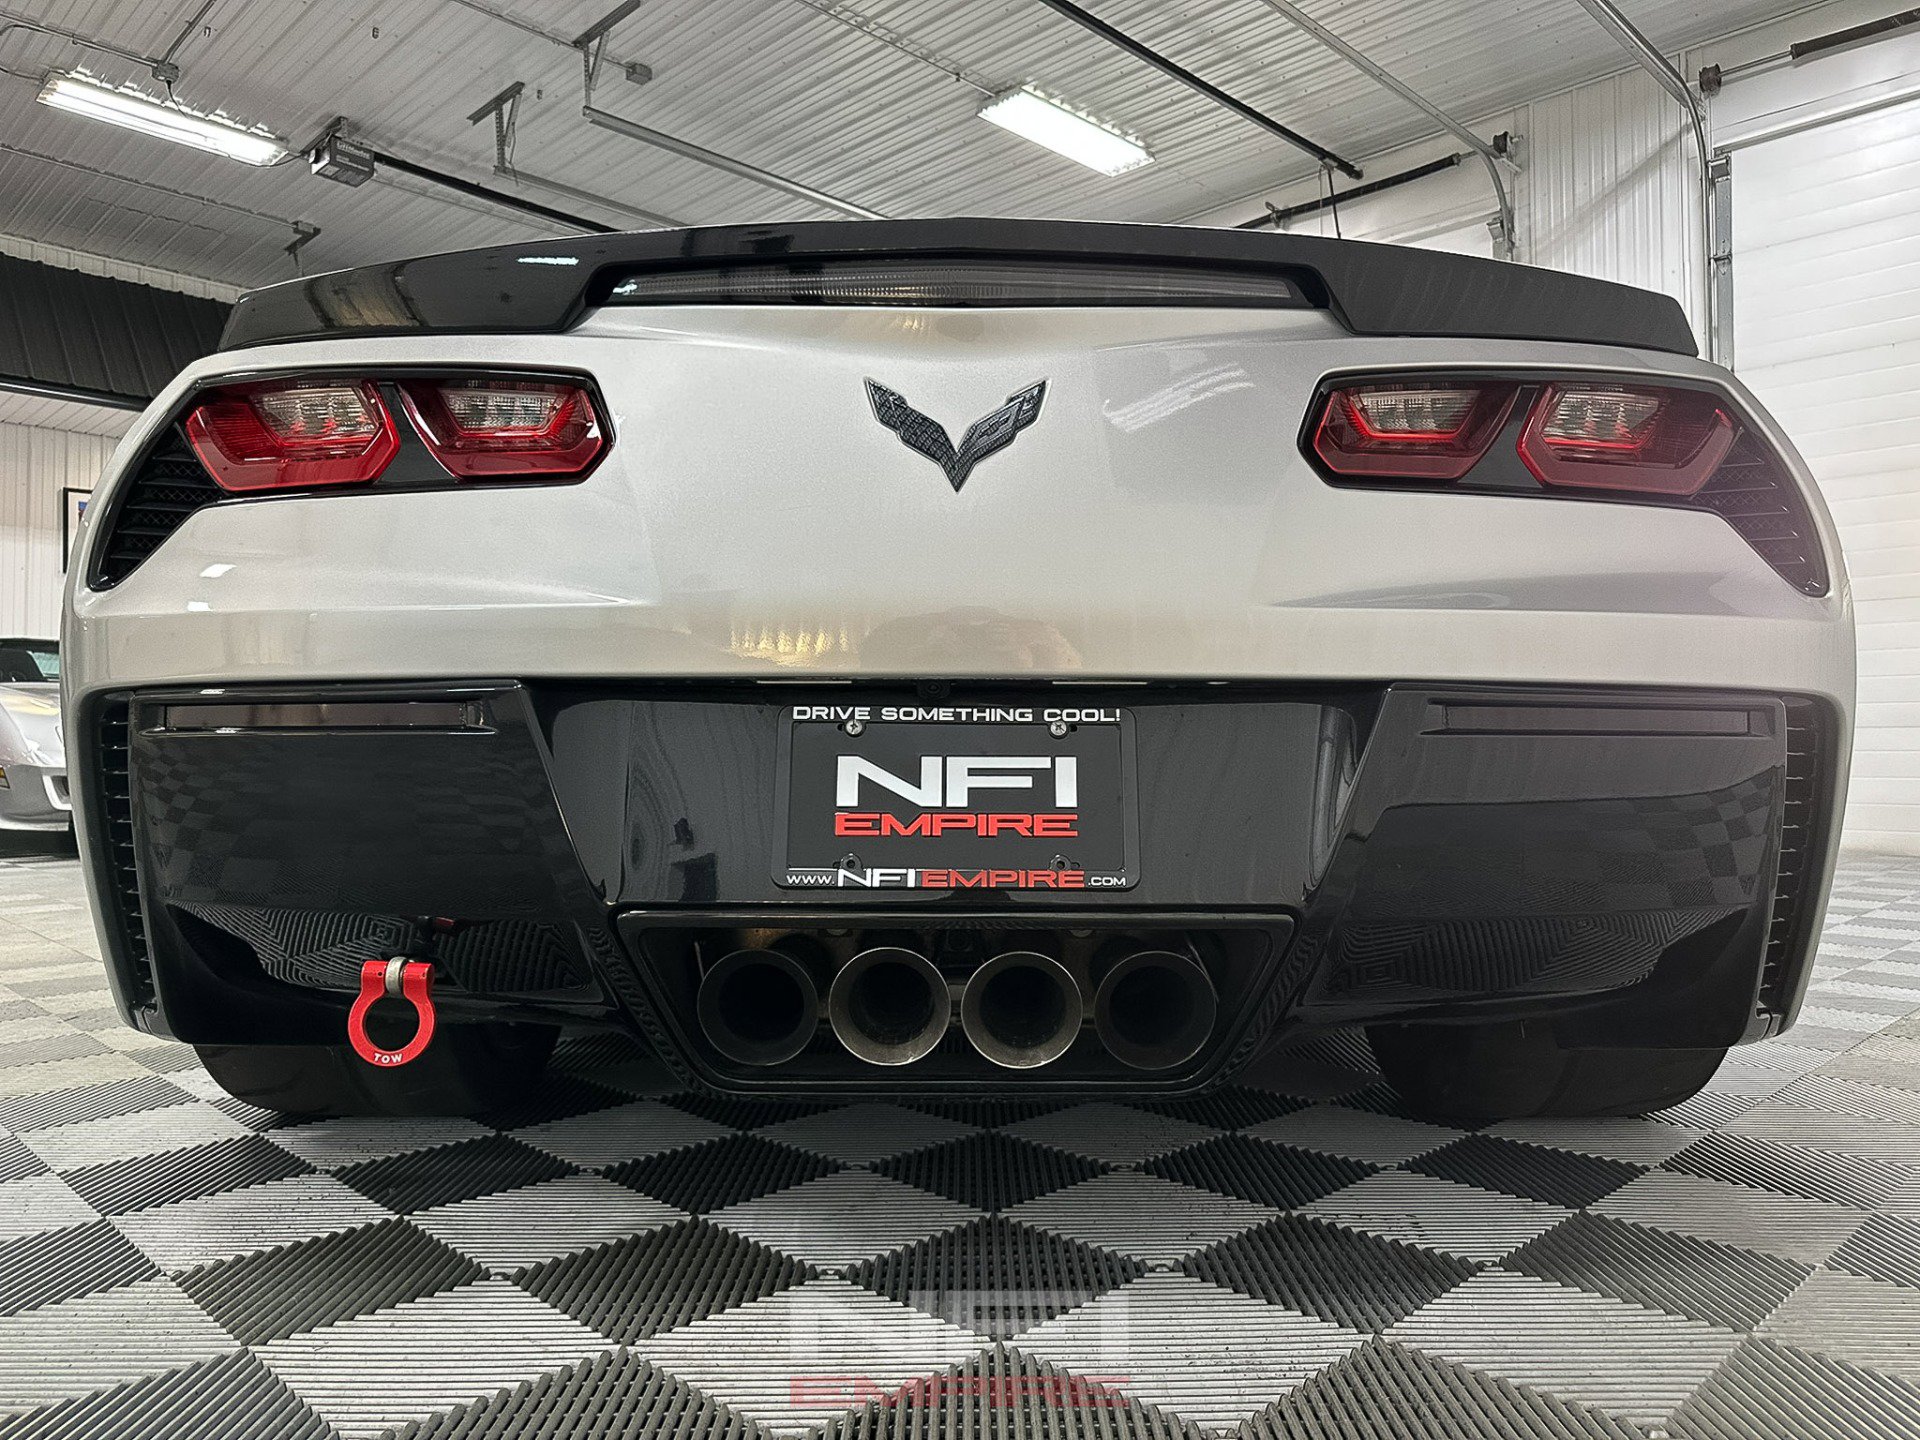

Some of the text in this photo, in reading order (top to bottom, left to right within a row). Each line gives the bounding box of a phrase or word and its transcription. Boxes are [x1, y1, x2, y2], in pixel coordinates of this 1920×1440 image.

[793, 706, 1122, 722] DRIVE SOMETHING COOL!
[836, 756, 1078, 808] NFI
[835, 813, 1079, 837] EMPIRE
[374, 1053, 402, 1064] TOW
